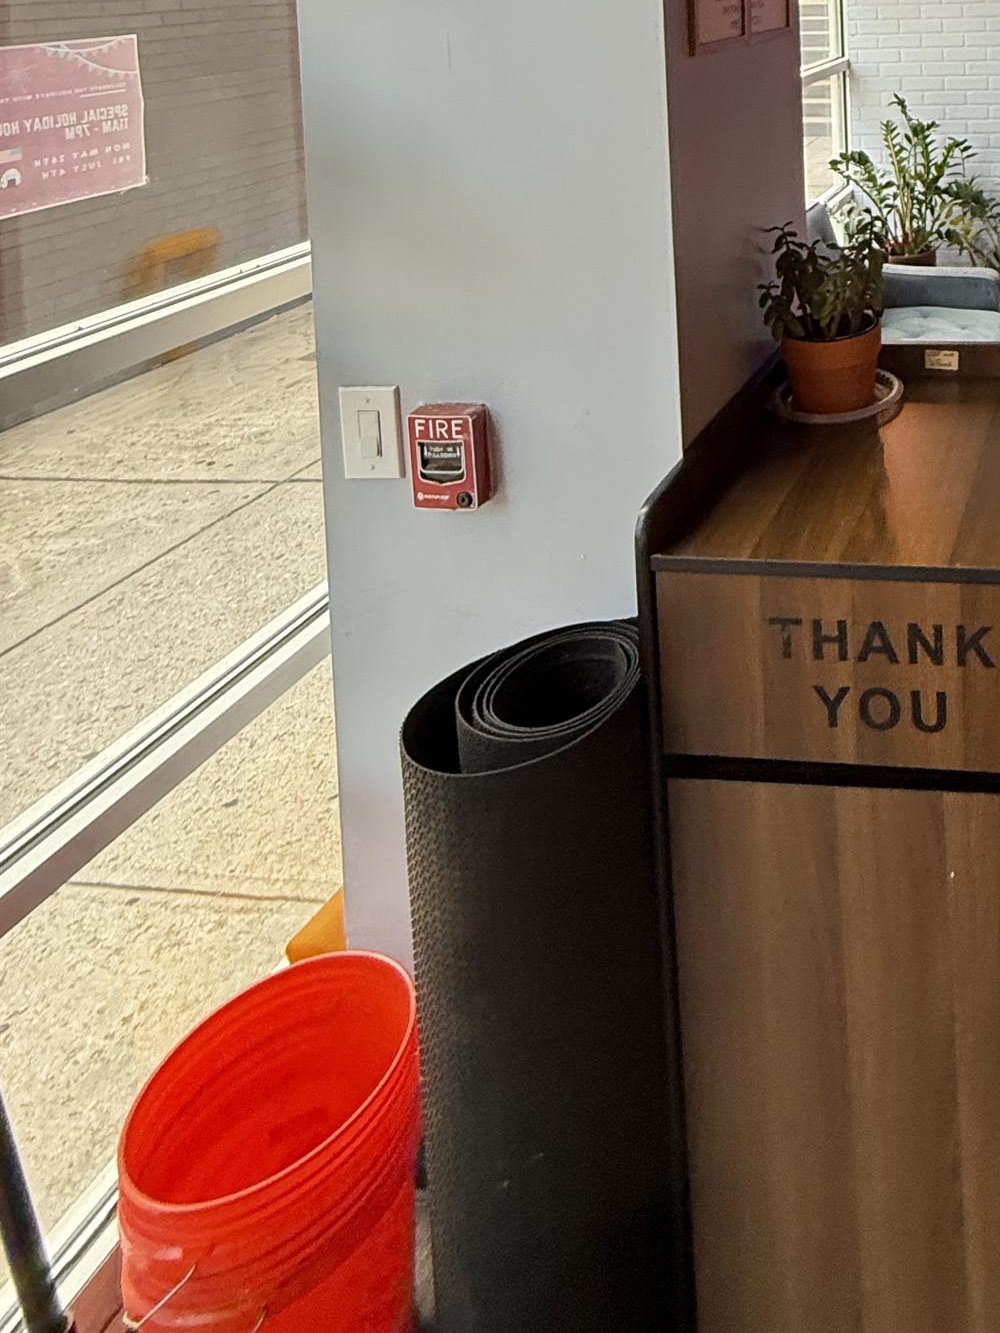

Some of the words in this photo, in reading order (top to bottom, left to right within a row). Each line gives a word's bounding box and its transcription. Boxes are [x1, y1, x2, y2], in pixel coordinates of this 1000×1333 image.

[414, 419, 464, 439] FIRE
[768, 617, 996, 668] THANK
[813, 685, 947, 733] YOU
